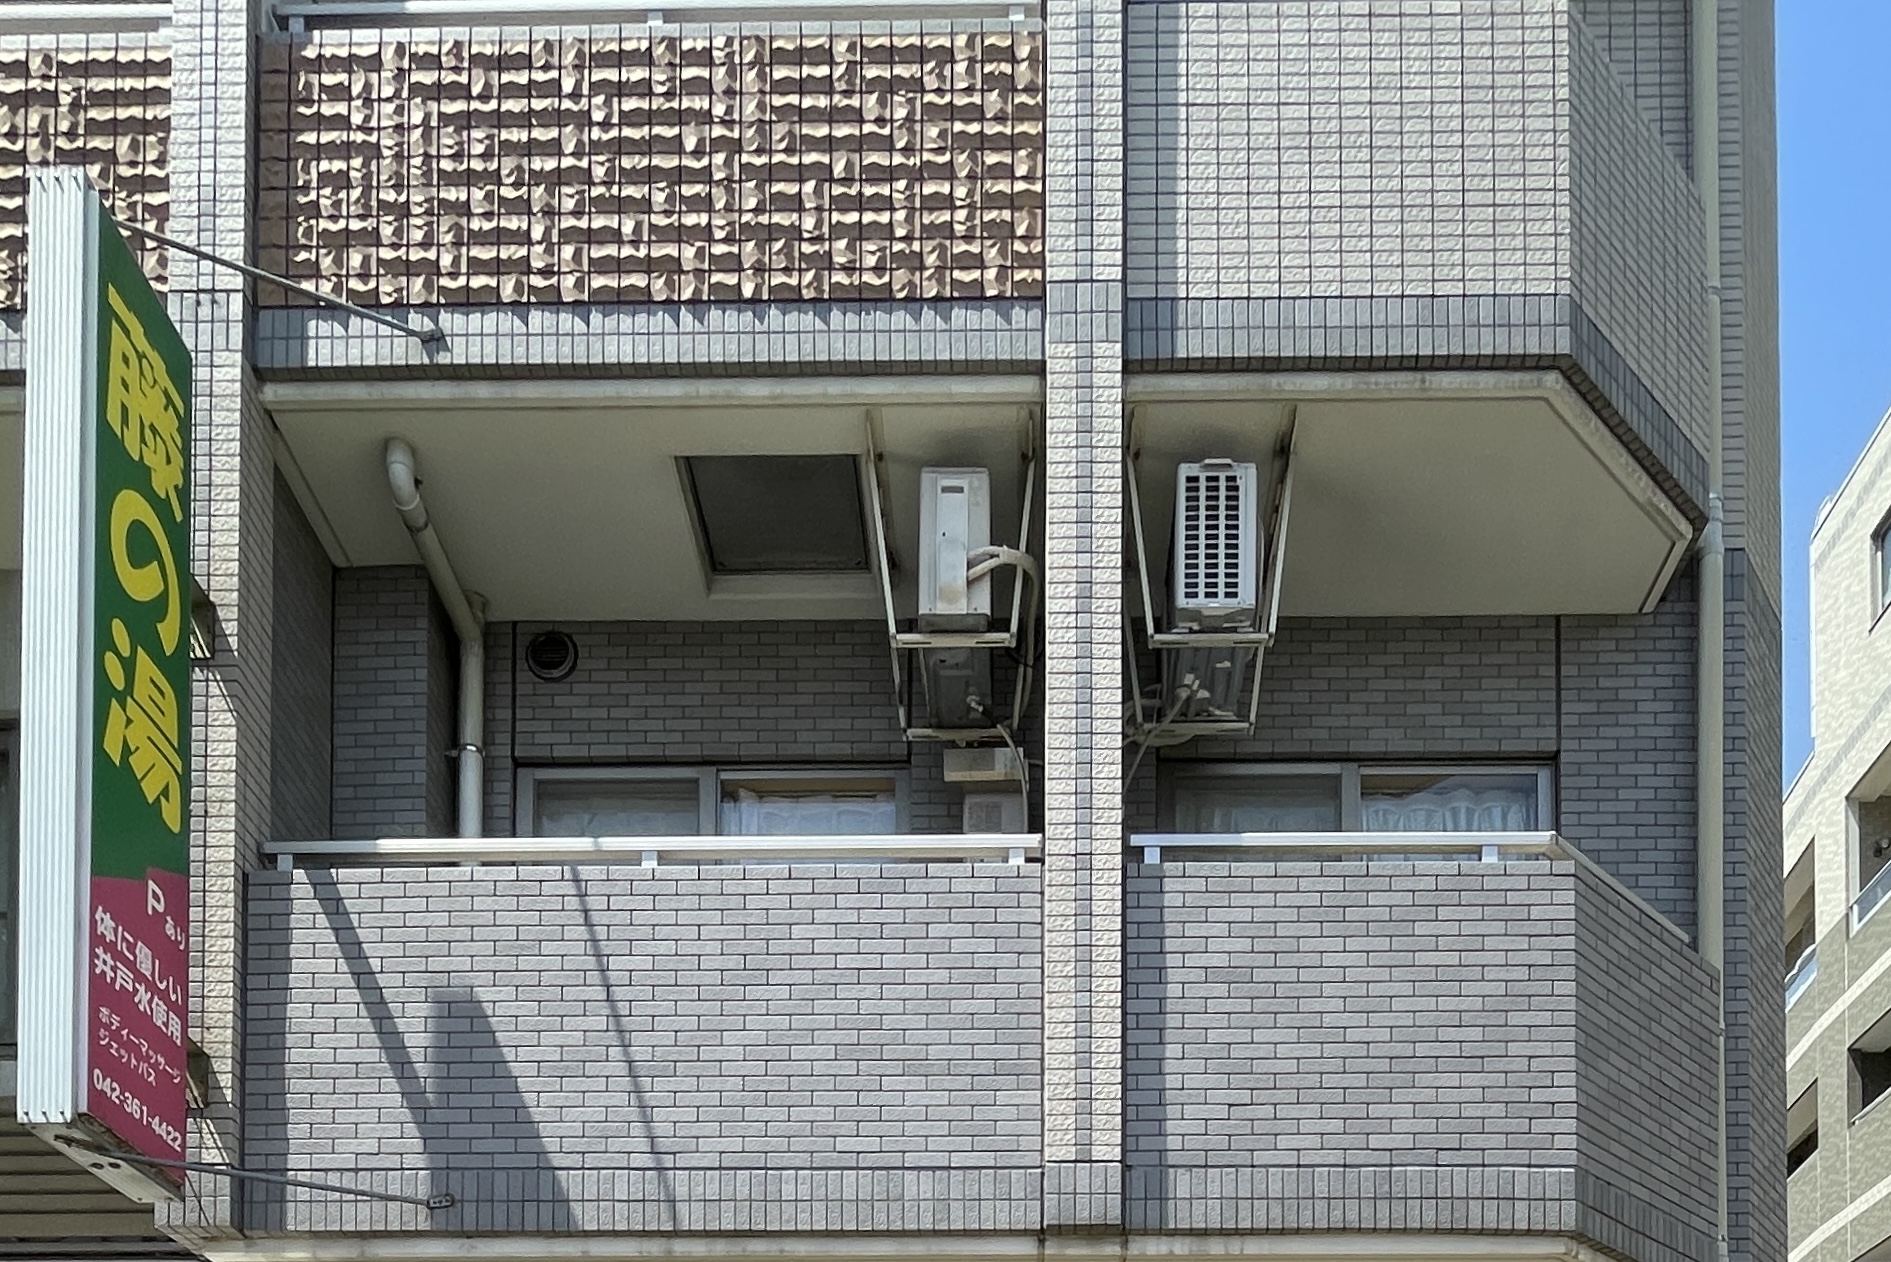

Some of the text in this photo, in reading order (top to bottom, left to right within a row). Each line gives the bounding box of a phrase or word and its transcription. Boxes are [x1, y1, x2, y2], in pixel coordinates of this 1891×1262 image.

[104, 283, 184, 834] 藤の湯
[95, 906, 182, 1005] 体に優しい
[95, 946, 182, 1046] 井戸水使用
[99, 1006, 182, 1084] ボディーマッサージ
[99, 1028, 157, 1087] ジェットバス
[93, 1068, 182, 1152] 042-361-4422
